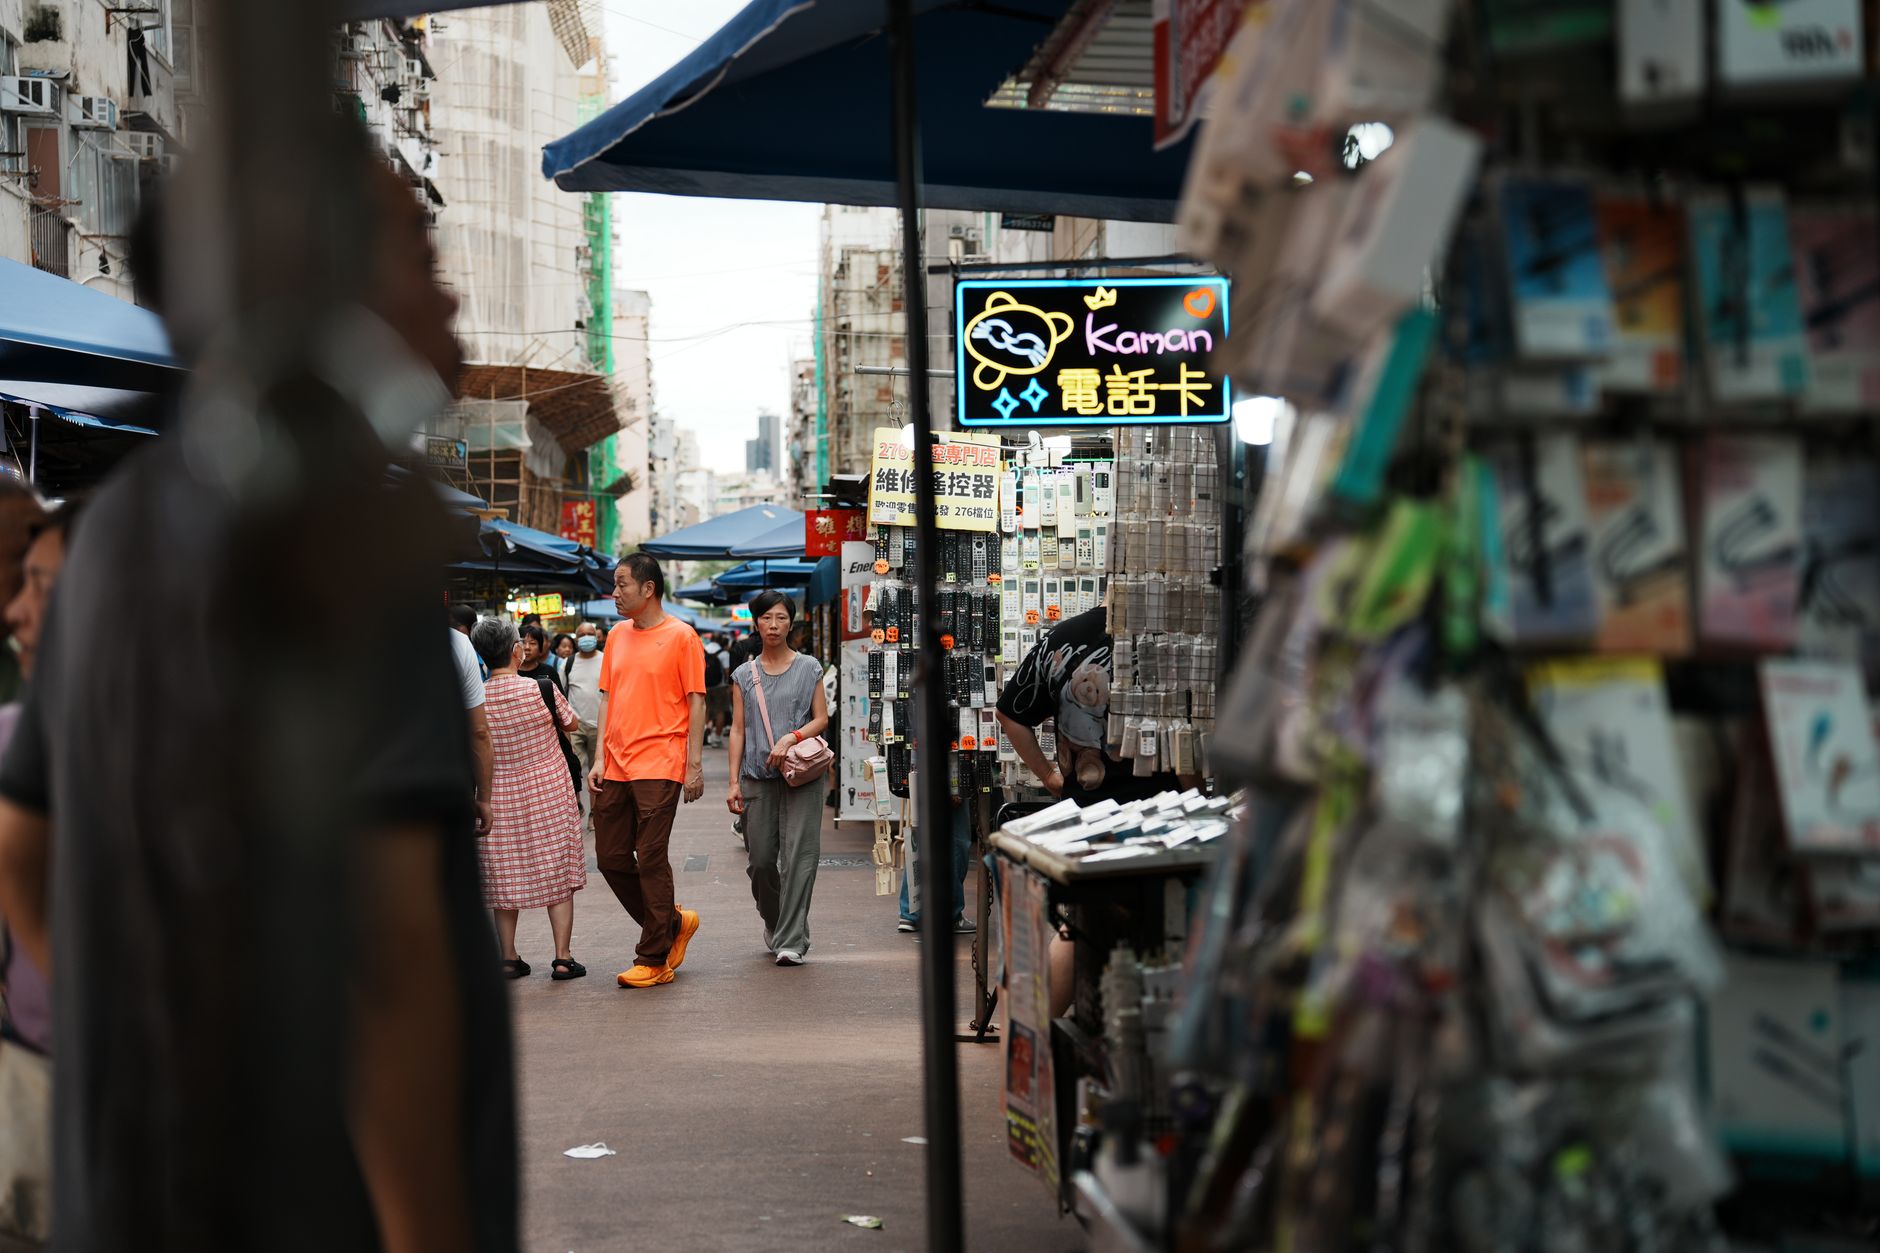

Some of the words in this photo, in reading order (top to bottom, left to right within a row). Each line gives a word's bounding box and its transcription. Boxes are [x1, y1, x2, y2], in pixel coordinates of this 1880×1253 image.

[1085, 312, 1213, 355] Kaman
[1057, 362, 1212, 416] 電話卡
